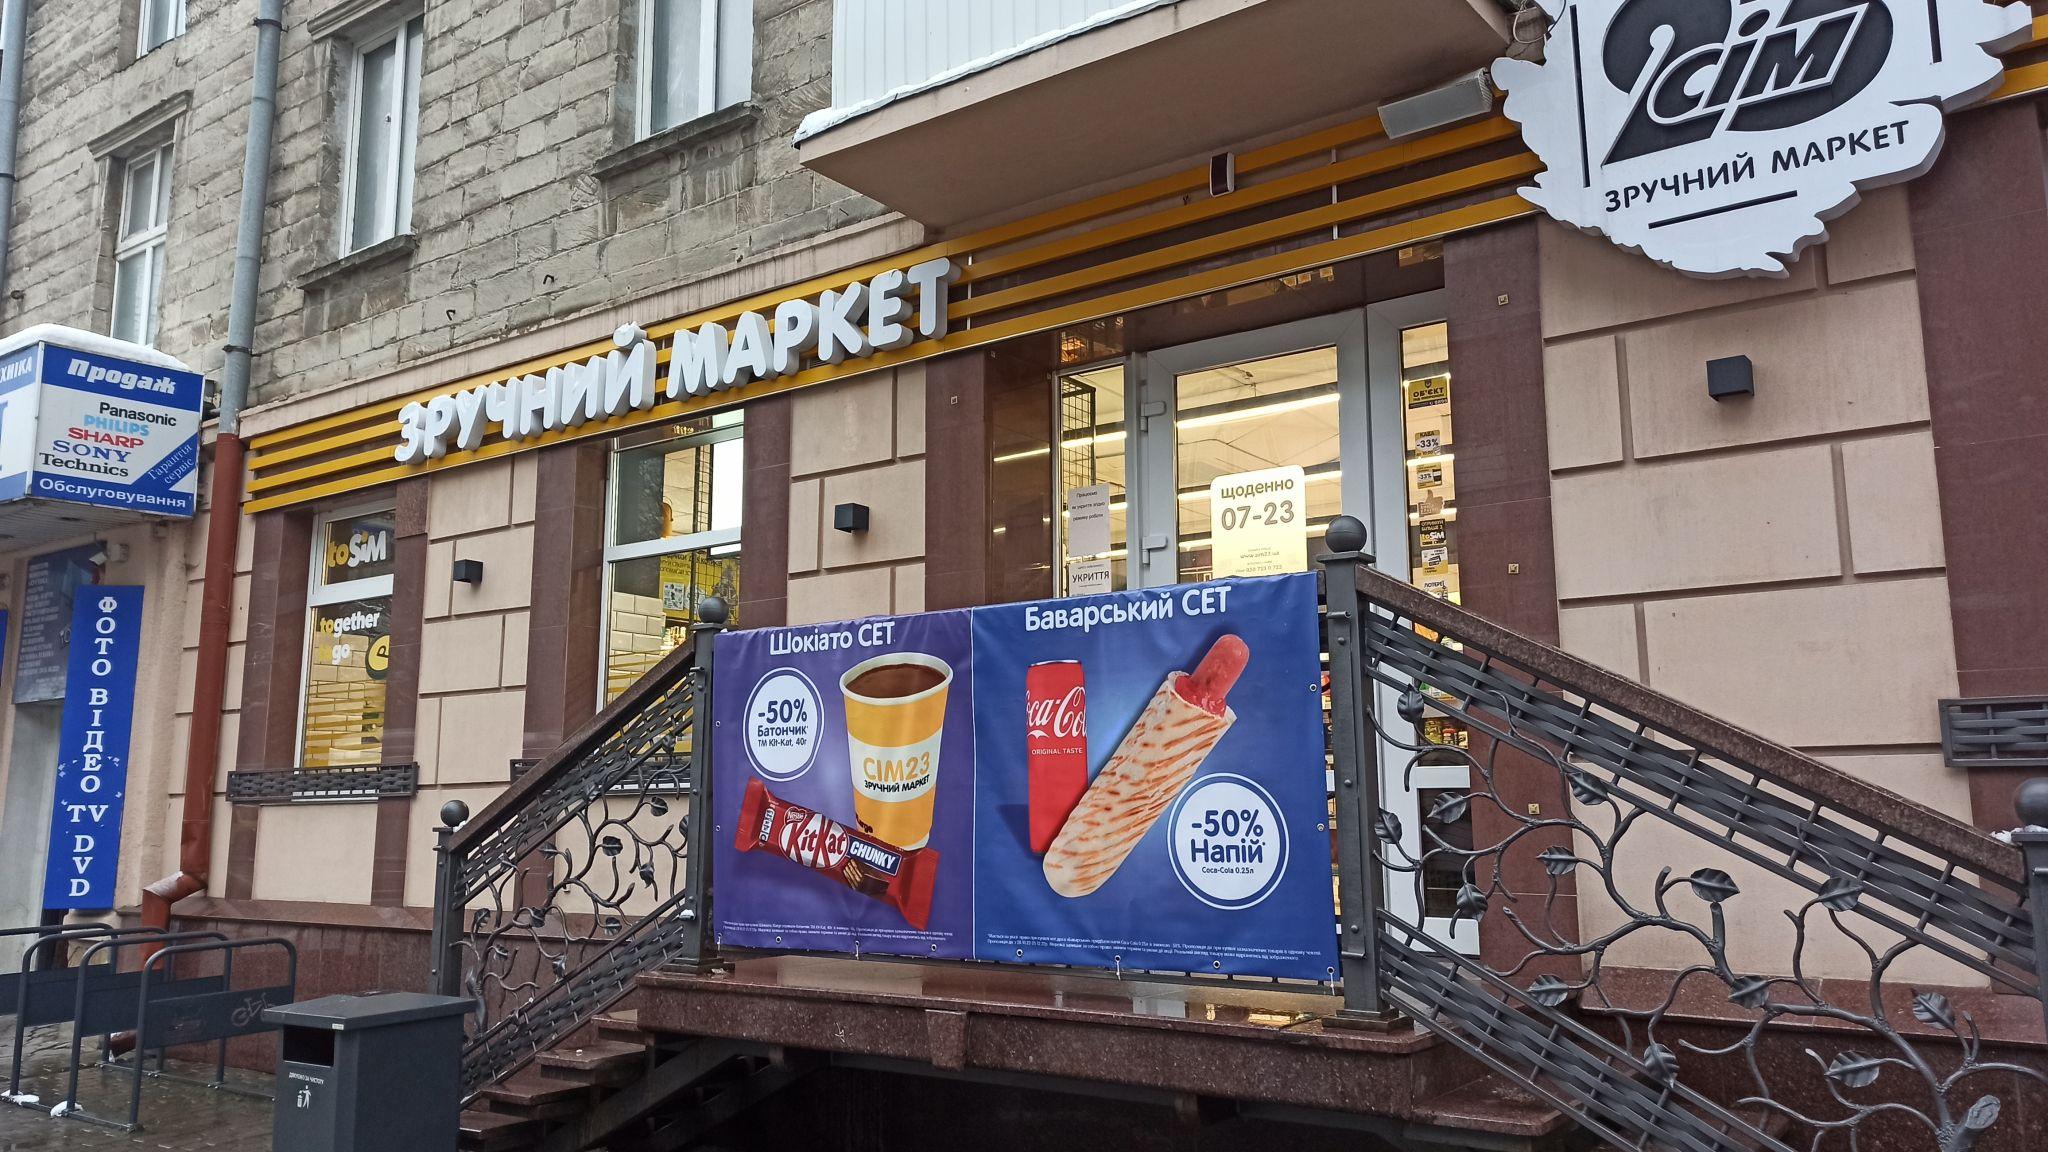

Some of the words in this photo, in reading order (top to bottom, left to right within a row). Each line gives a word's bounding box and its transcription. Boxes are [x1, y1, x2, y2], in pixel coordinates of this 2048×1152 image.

[1604, 152, 1755, 213] ЗРУЧНИЙ
[1770, 120, 1910, 174] МАРКЕТ
[394, 321, 657, 465] ЗРУЧНИЙ
[667, 257, 957, 401] МАРКЕТ
[67, 357, 177, 396] Продаж
[83, 414, 150, 437] PHILIPS
[99, 401, 177, 427] Panasonic
[52, 440, 132, 463] SONY
[67, 427, 145, 449] SHARP
[1416, 438, 1439, 448] -33%
[39, 452, 129, 478] Technics
[163, 457, 195, 485] сервіс
[39, 478, 187, 508] Обслуговування
[1221, 479, 1294, 500] щоденно
[1221, 500, 1295, 531] 07-23
[1071, 570, 1110, 583] УКРИТТЯ
[1025, 593, 1173, 633] Баварський
[1181, 586, 1232, 615] СЕТ
[91, 596, 119, 677] ФОТО
[320, 611, 379, 638] together
[769, 629, 853, 656] Шокіато
[857, 621, 895, 648] СЕТ
[757, 697, 808, 724] -50%
[80, 687, 109, 794] ВІДЕО
[1031, 748, 1062, 756] ORIGINAL
[1063, 747, 1084, 755] TASTE
[864, 779, 900, 793] ЗРУЧНИЙ
[901, 774, 930, 792] МАРКЕТ
[66, 804, 109, 823] TV
[1191, 808, 1264, 837] -50%
[68, 834, 95, 897] DVD
[849, 841, 898, 870] CHUNKY
[1201, 866, 1234, 875] Coca-Cola
